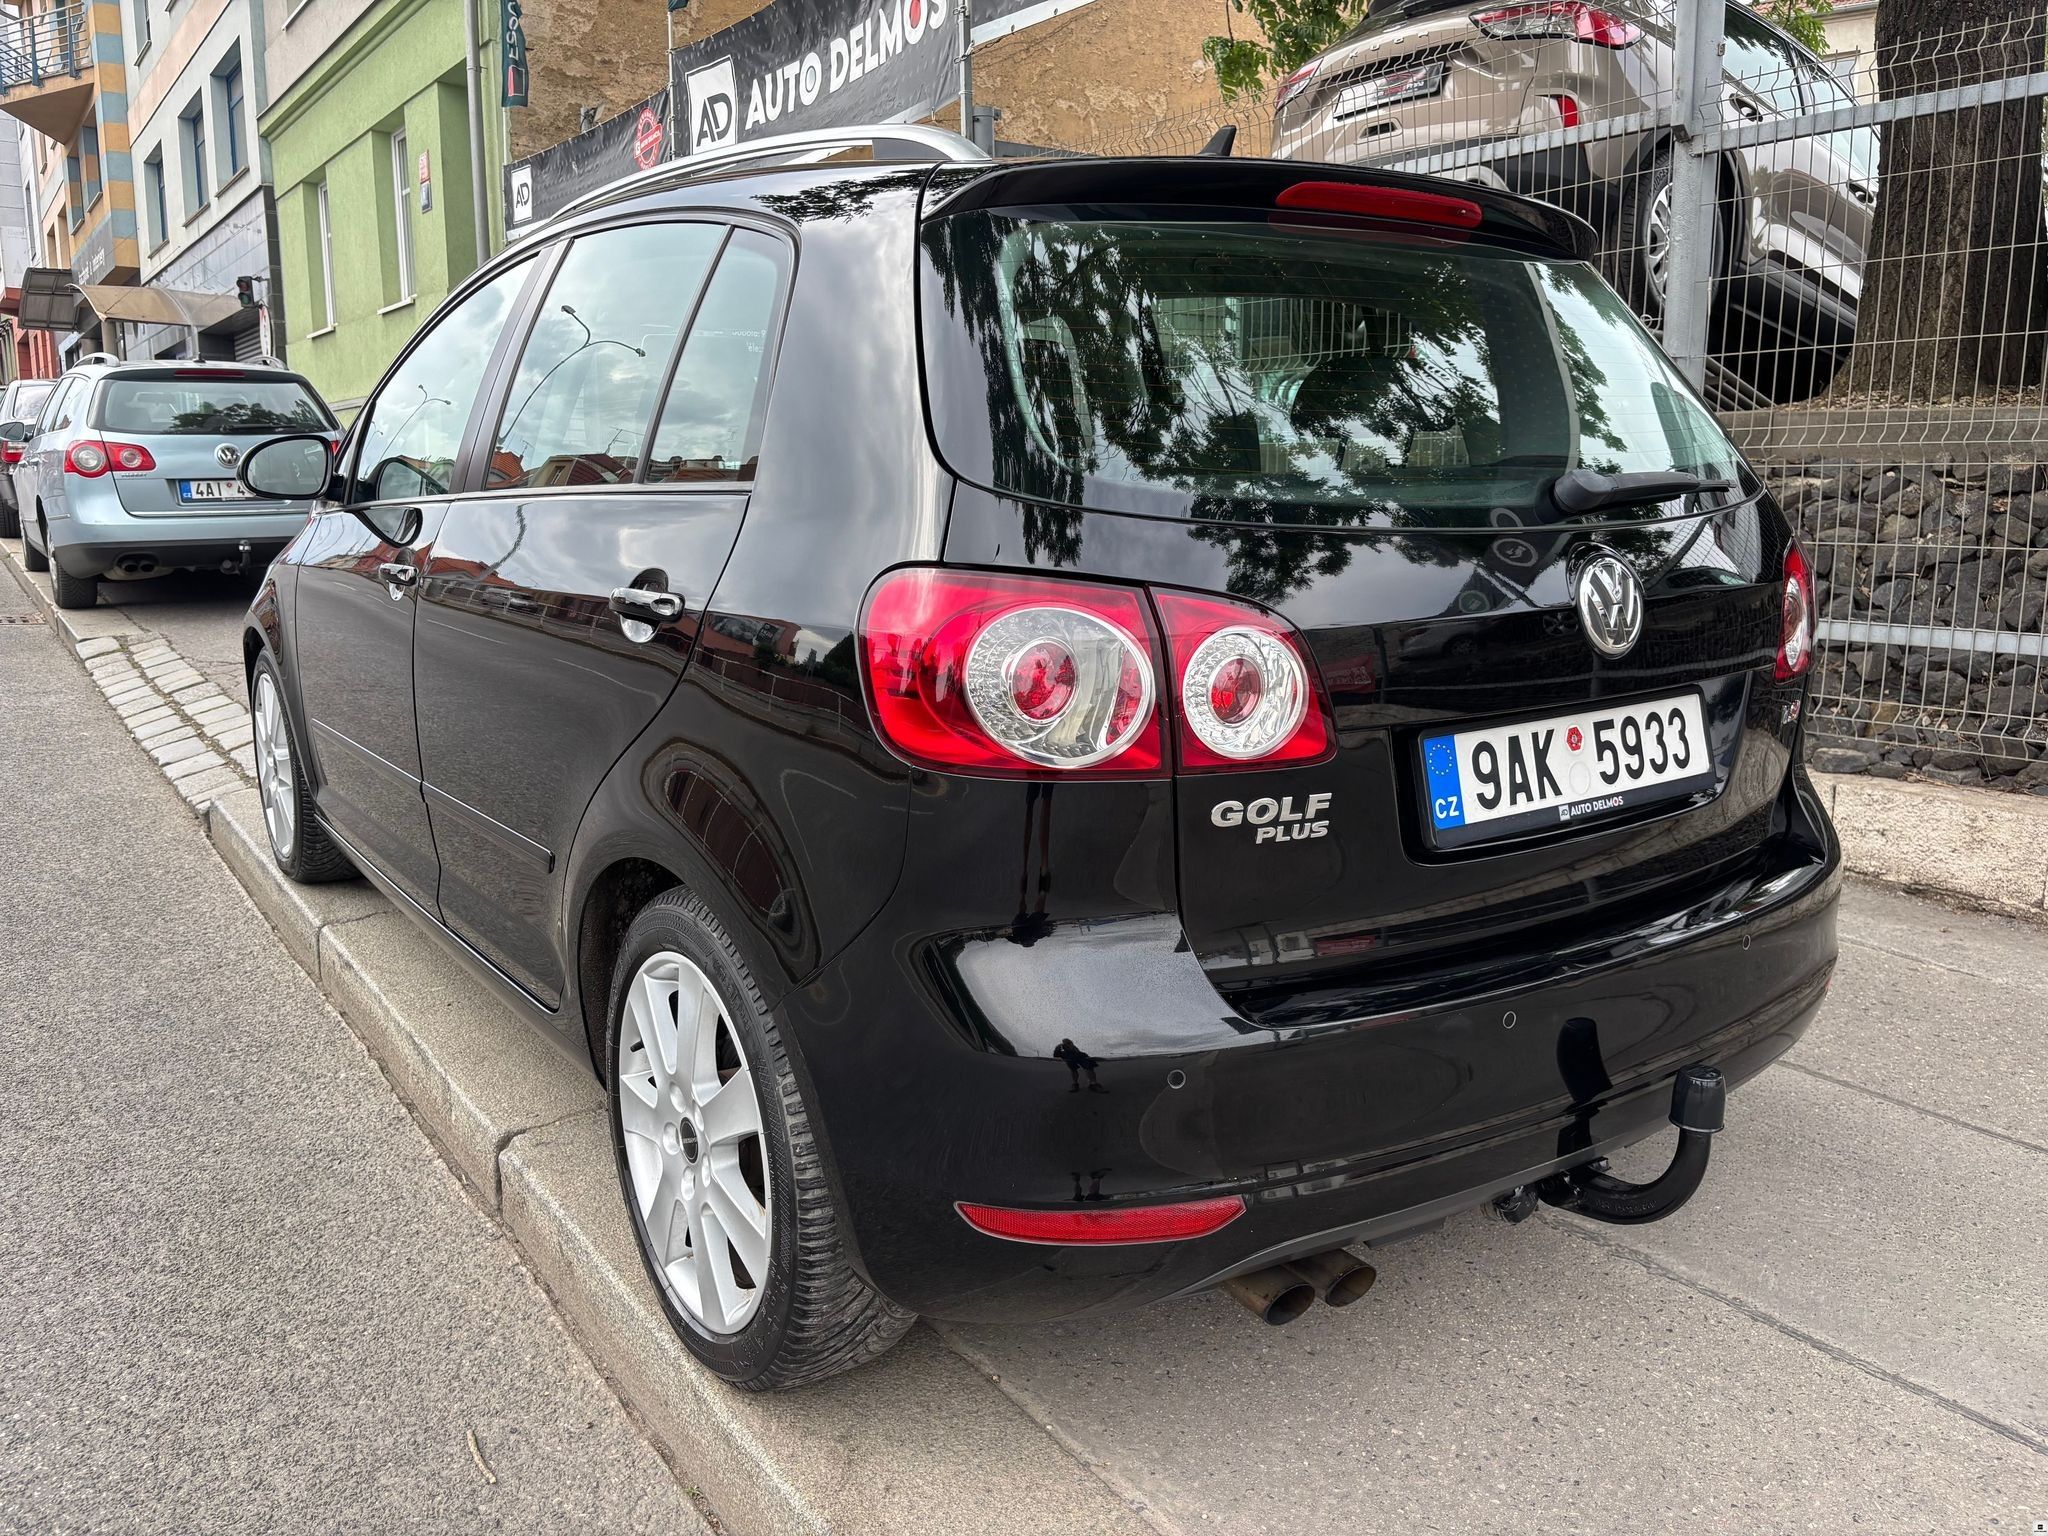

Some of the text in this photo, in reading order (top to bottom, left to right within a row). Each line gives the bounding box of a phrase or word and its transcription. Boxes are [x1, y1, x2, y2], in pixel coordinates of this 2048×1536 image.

[745, 52, 822, 131] AUTO
[829, 0, 947, 93] DELMOS
[1471, 707, 1691, 810] 9AK 5933
[1210, 792, 1332, 827] GOLF
[1435, 795, 1460, 819] CZ
[1570, 803, 1592, 817] AUTO
[1592, 796, 1624, 811] DELMOS
[1256, 820, 1330, 844] PLUS
